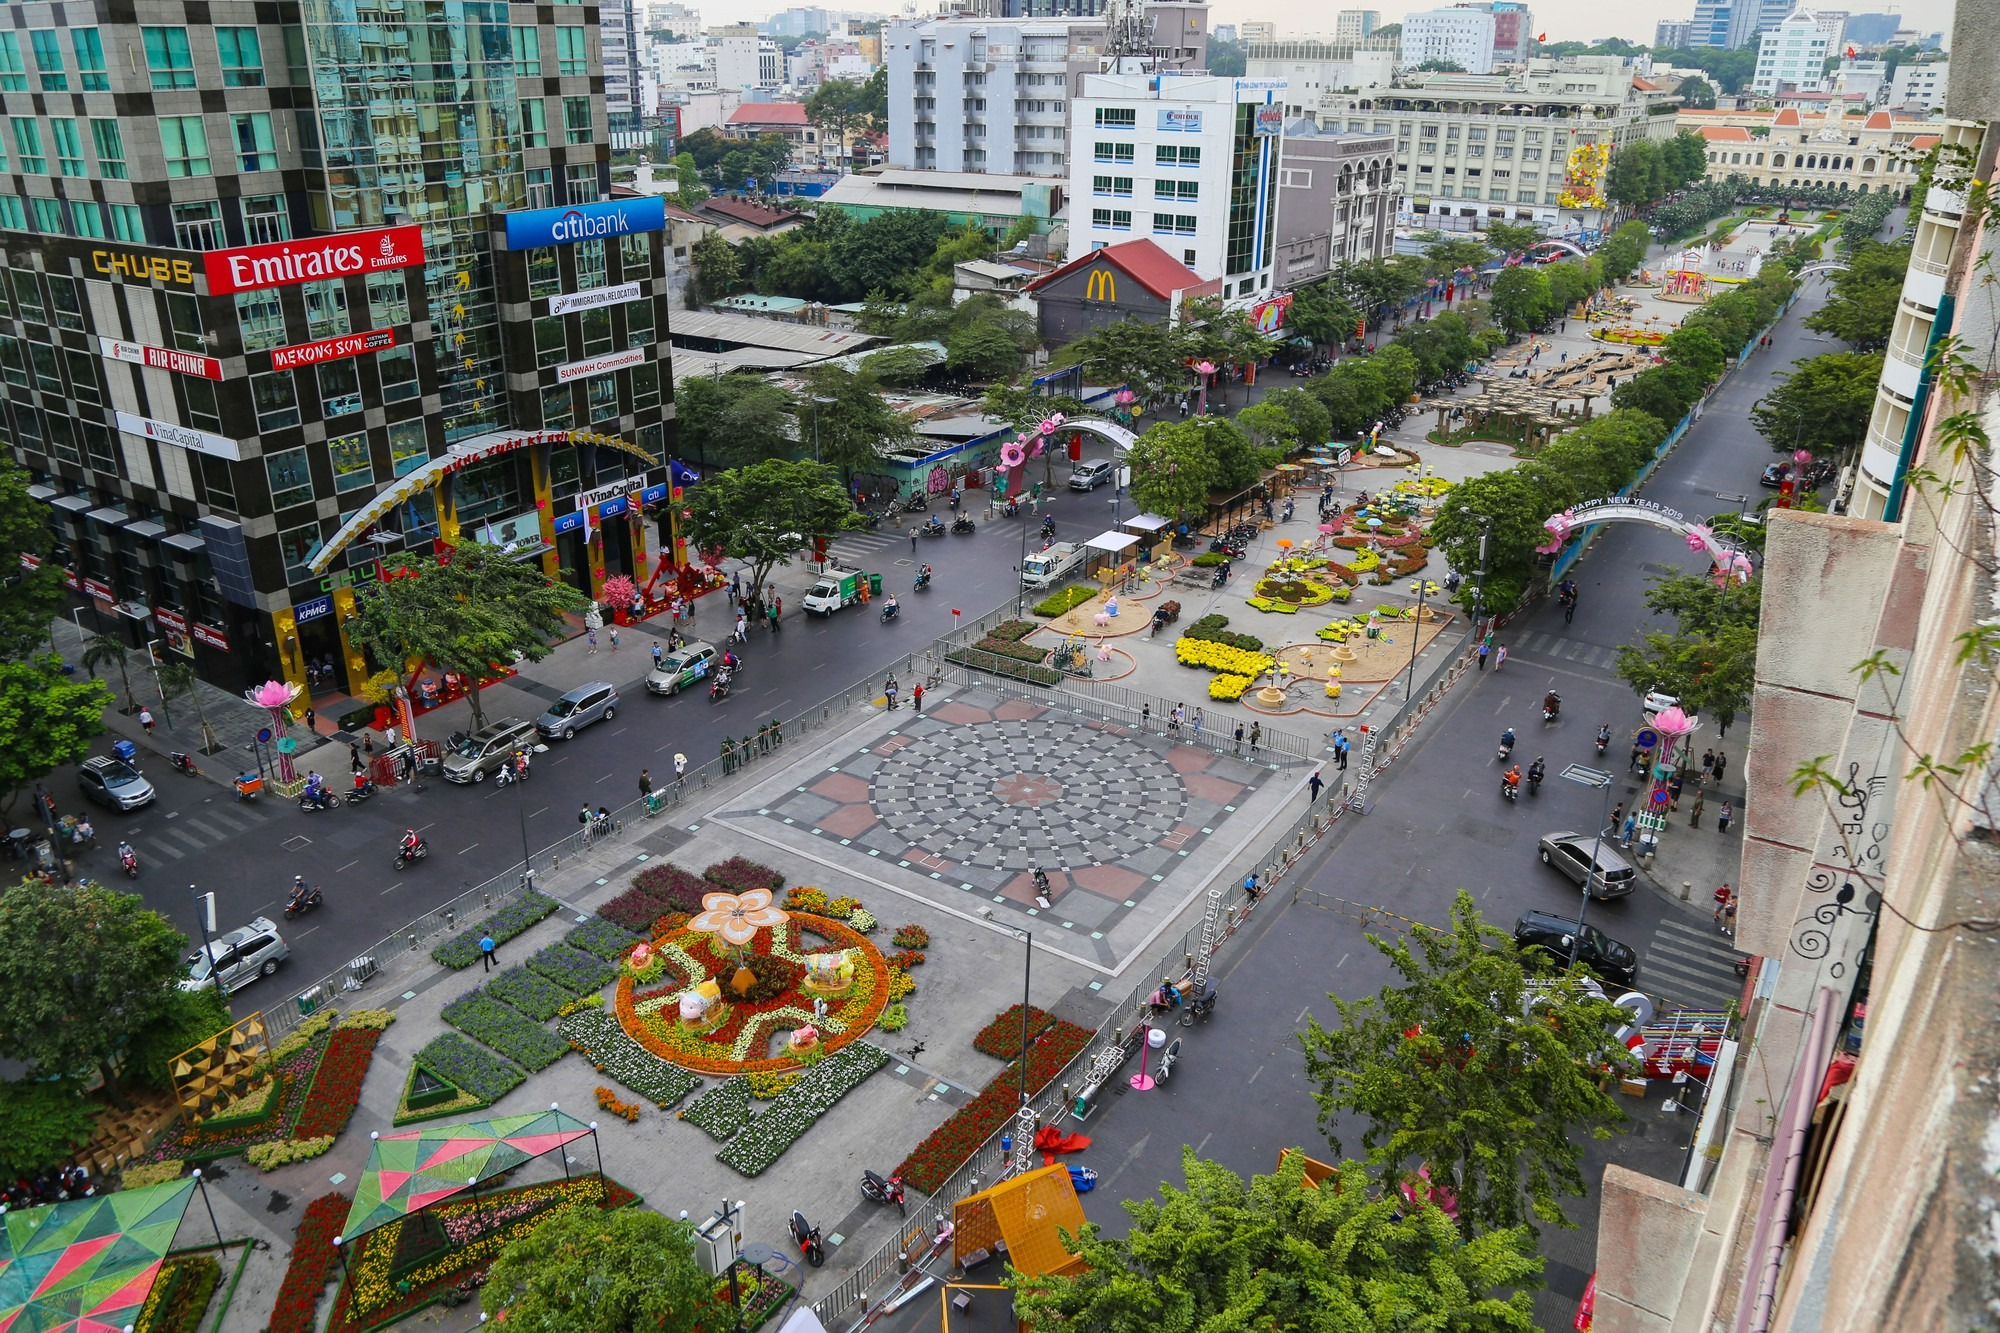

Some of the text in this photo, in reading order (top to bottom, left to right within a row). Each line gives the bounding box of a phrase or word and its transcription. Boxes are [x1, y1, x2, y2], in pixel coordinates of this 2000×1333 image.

[552, 209, 629, 241] citibank
[92, 250, 193, 284] CHUBB
[227, 245, 364, 288] Emirates
[370, 255, 408, 268] Emirates
[571, 293, 606, 307] IMMIGRATION
[608, 287, 639, 301] RELOCATION
[366, 333, 389, 342] VIETNAM
[148, 349, 206, 376] AIR CHINA
[274, 337, 393, 366] MEKONG SUN COFFEE
[560, 353, 643, 379] SUNWAH Commodities
[152, 423, 205, 449] VinaCapital
[589, 477, 645, 503] VinaCapital
[648, 490, 660, 501] citi
[606, 503, 619, 515] citi
[1570, 496, 1684, 520] HAPPY NEW YEAR 2019
[562, 518, 575, 530] citi
[299, 604, 327, 620] KPMG
